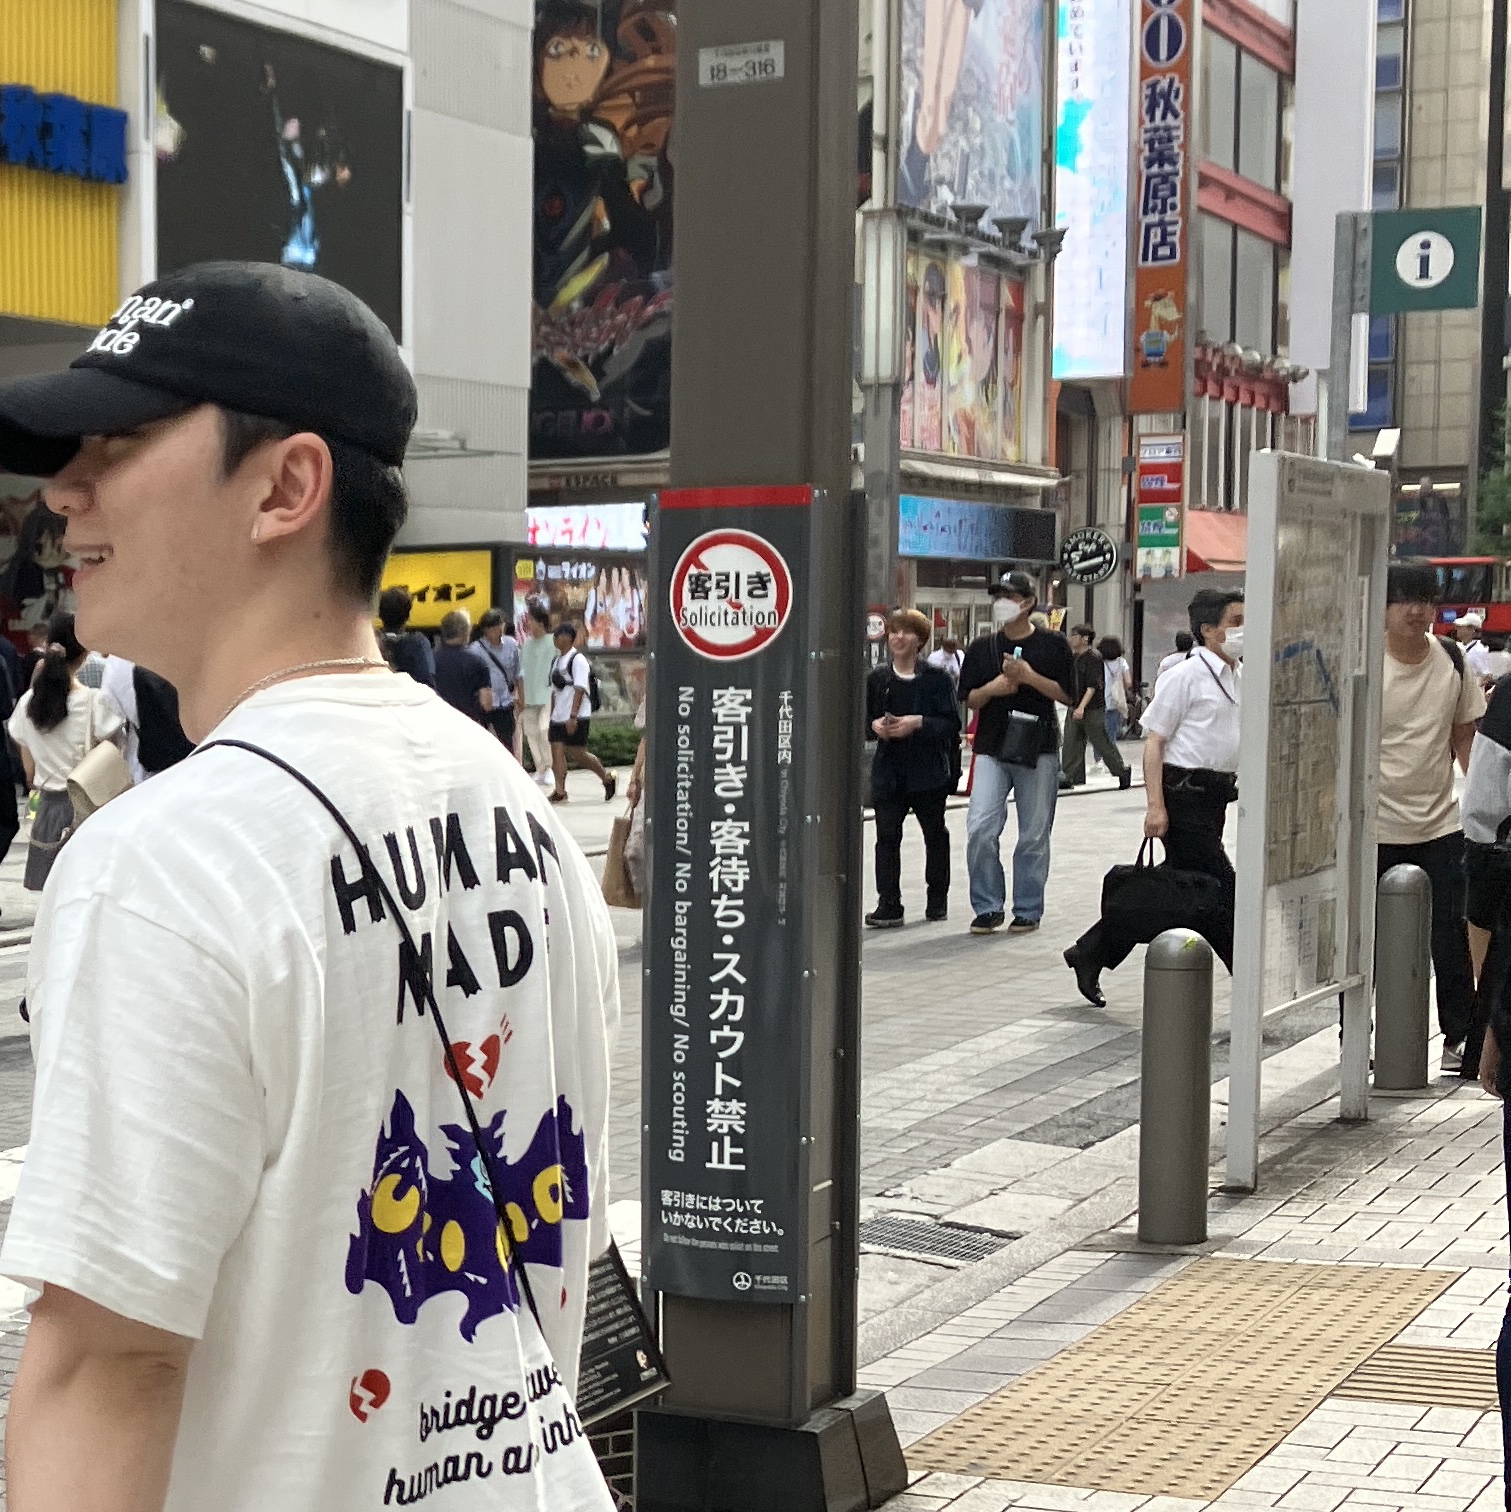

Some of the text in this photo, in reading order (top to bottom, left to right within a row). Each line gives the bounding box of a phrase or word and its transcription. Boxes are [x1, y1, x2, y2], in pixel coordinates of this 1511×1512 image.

[1140, 74, 1183, 265] 秋葉原店
[688, 571, 772, 601] 客引き
[681, 607, 778, 628] Solicitation
[777, 690, 794, 764] 千代田区内
[668, 686, 695, 1163] No solicitation/ No bargaining/ No scouting
[704, 686, 754, 1171] 客引き・客待ち・スカウト禁止
[397, 908, 551, 1026] MAD
[661, 1189, 764, 1214] 客引きにはついて
[661, 1209, 785, 1237] いかないでください。
[419, 1385, 527, 1443] bridge
[383, 1450, 493, 1506] human
